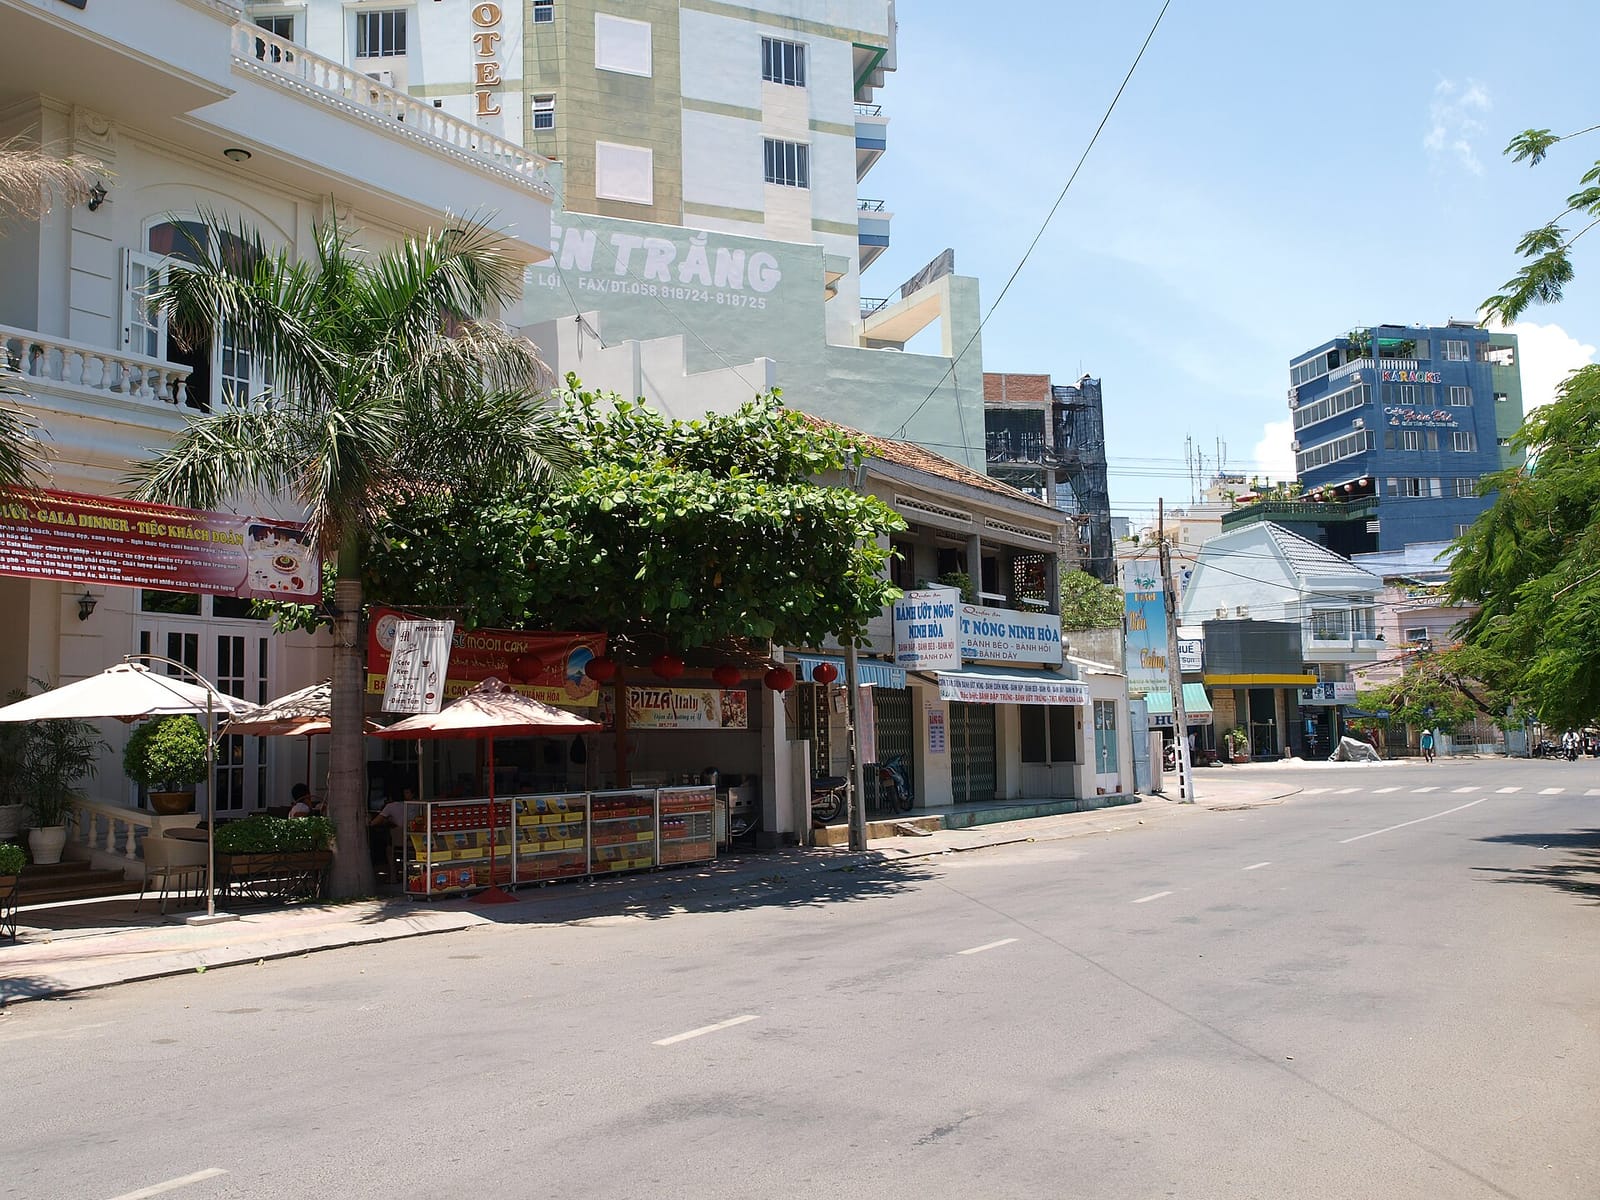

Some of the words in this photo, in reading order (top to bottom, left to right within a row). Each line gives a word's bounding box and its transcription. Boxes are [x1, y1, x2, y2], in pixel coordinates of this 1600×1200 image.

[610, 232, 781, 293] TRẮNG
[538, 273, 561, 290] LỢI
[1382, 370, 1442, 384] KARAOKE
[37, 508, 77, 526] GALA
[79, 514, 130, 533] DINNER
[137, 519, 167, 538] TIỆC
[168, 523, 209, 542] KHÁCH
[212, 528, 244, 545] ĐOÀN
[896, 602, 916, 621] BÁNH
[917, 601, 932, 620] ƯỚT
[933, 600, 954, 619] NÓNG
[908, 624, 926, 639] NINH
[928, 620, 944, 638] HÒA
[973, 618, 1006, 638] NÓNG
[1008, 624, 1035, 641] NINH
[1038, 624, 1060, 643] HÒA
[967, 638, 992, 648] BÁNH
[1016, 642, 1037, 653] BÁNH
[979, 649, 1001, 660] BÁNH
[630, 690, 671, 711] PIZZA
[675, 694, 699, 712] Italy
[1155, 714, 1174, 725] HU
